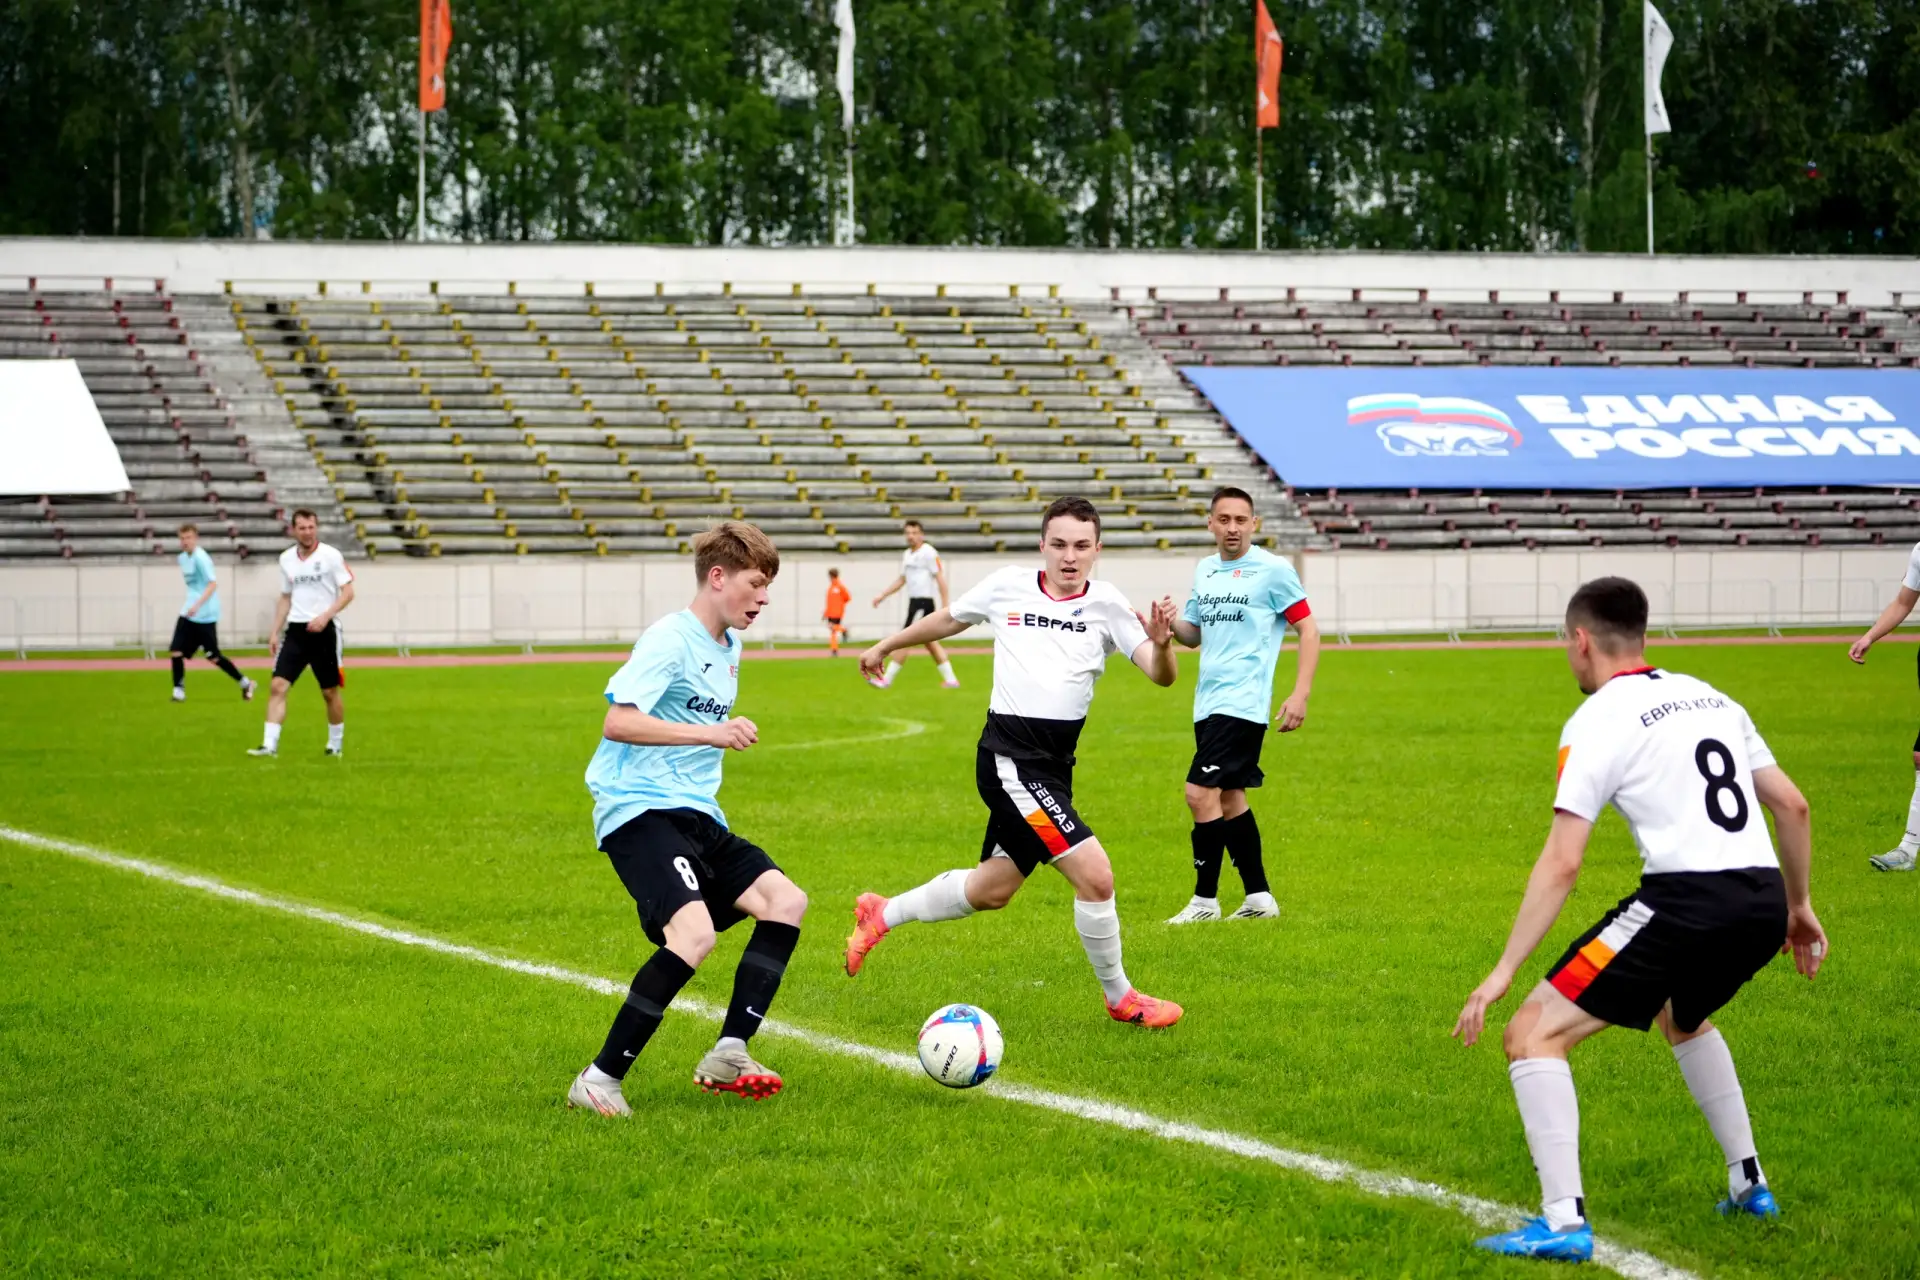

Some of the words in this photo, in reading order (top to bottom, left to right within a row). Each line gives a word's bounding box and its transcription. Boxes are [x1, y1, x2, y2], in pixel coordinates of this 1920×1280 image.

[1516, 394, 1896, 427] ЕДИНАЯ
[1548, 427, 1920, 459] РОССИЯ
[1024, 613, 1087, 632] ЕВРАЗ
[1640, 700, 1692, 728] ЕВРАЗ
[1695, 737, 1748, 833] 8
[1035, 786, 1076, 833] ЕВРАЗ
[673, 856, 699, 891] 8
[941, 1045, 958, 1079] DEMIX
